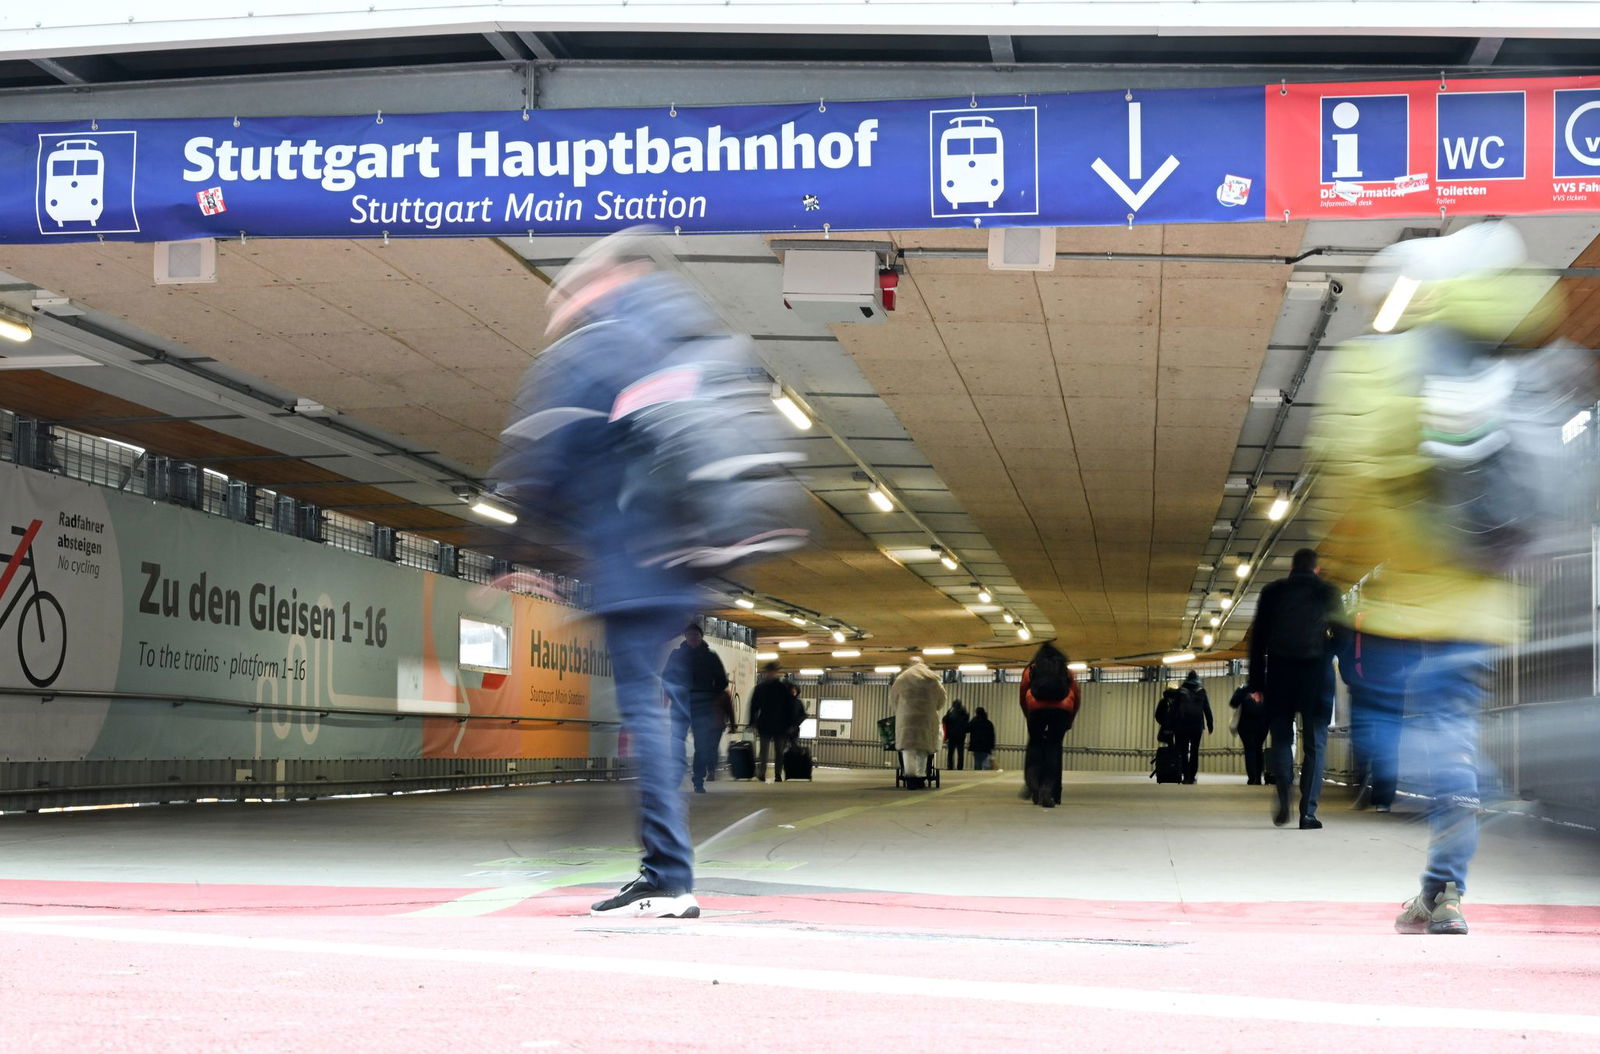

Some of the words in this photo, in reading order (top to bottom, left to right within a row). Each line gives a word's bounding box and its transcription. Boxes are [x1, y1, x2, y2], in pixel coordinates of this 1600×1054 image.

[183, 136, 439, 190] Stuttgart
[457, 118, 879, 187] Hauptbahnhof
[1443, 135, 1505, 170] WC
[1436, 185, 1487, 196] Toiletten
[1553, 183, 1576, 193] VVS
[351, 194, 492, 229] Stuttgart
[504, 192, 583, 222] Main
[594, 189, 707, 221] Station
[59, 511, 104, 534] Radfahrer
[58, 534, 102, 556] absteigen
[58, 555, 69, 570] No
[71, 559, 100, 579] cycling
[139, 561, 179, 618] Zu
[189, 571, 240, 626] den
[249, 583, 335, 640] Gleisen
[139, 641, 155, 667] To
[160, 643, 181, 669] the
[184, 648, 219, 673] trains
[229, 652, 279, 681] platform
